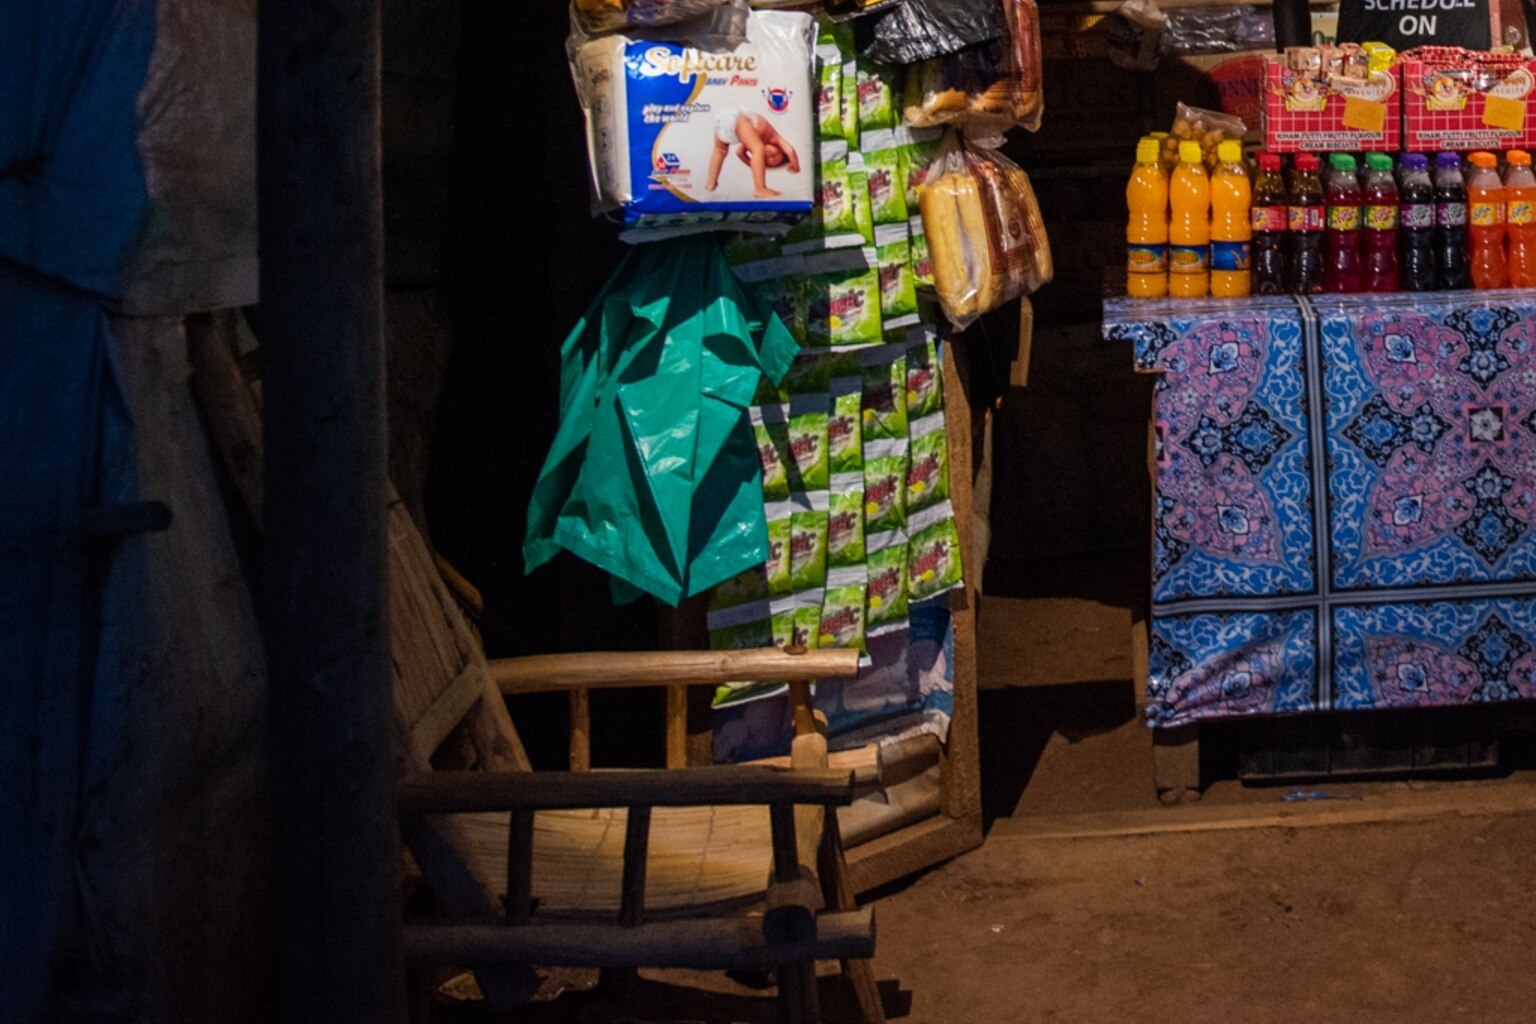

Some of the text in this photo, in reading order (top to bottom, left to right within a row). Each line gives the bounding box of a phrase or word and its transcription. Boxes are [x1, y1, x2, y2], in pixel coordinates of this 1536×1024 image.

[1399, 15, 1437, 36] ON
[640, 47, 757, 84] Softcare
[662, 112, 689, 123] world
[1467, 140, 1499, 148] BISCUITS
